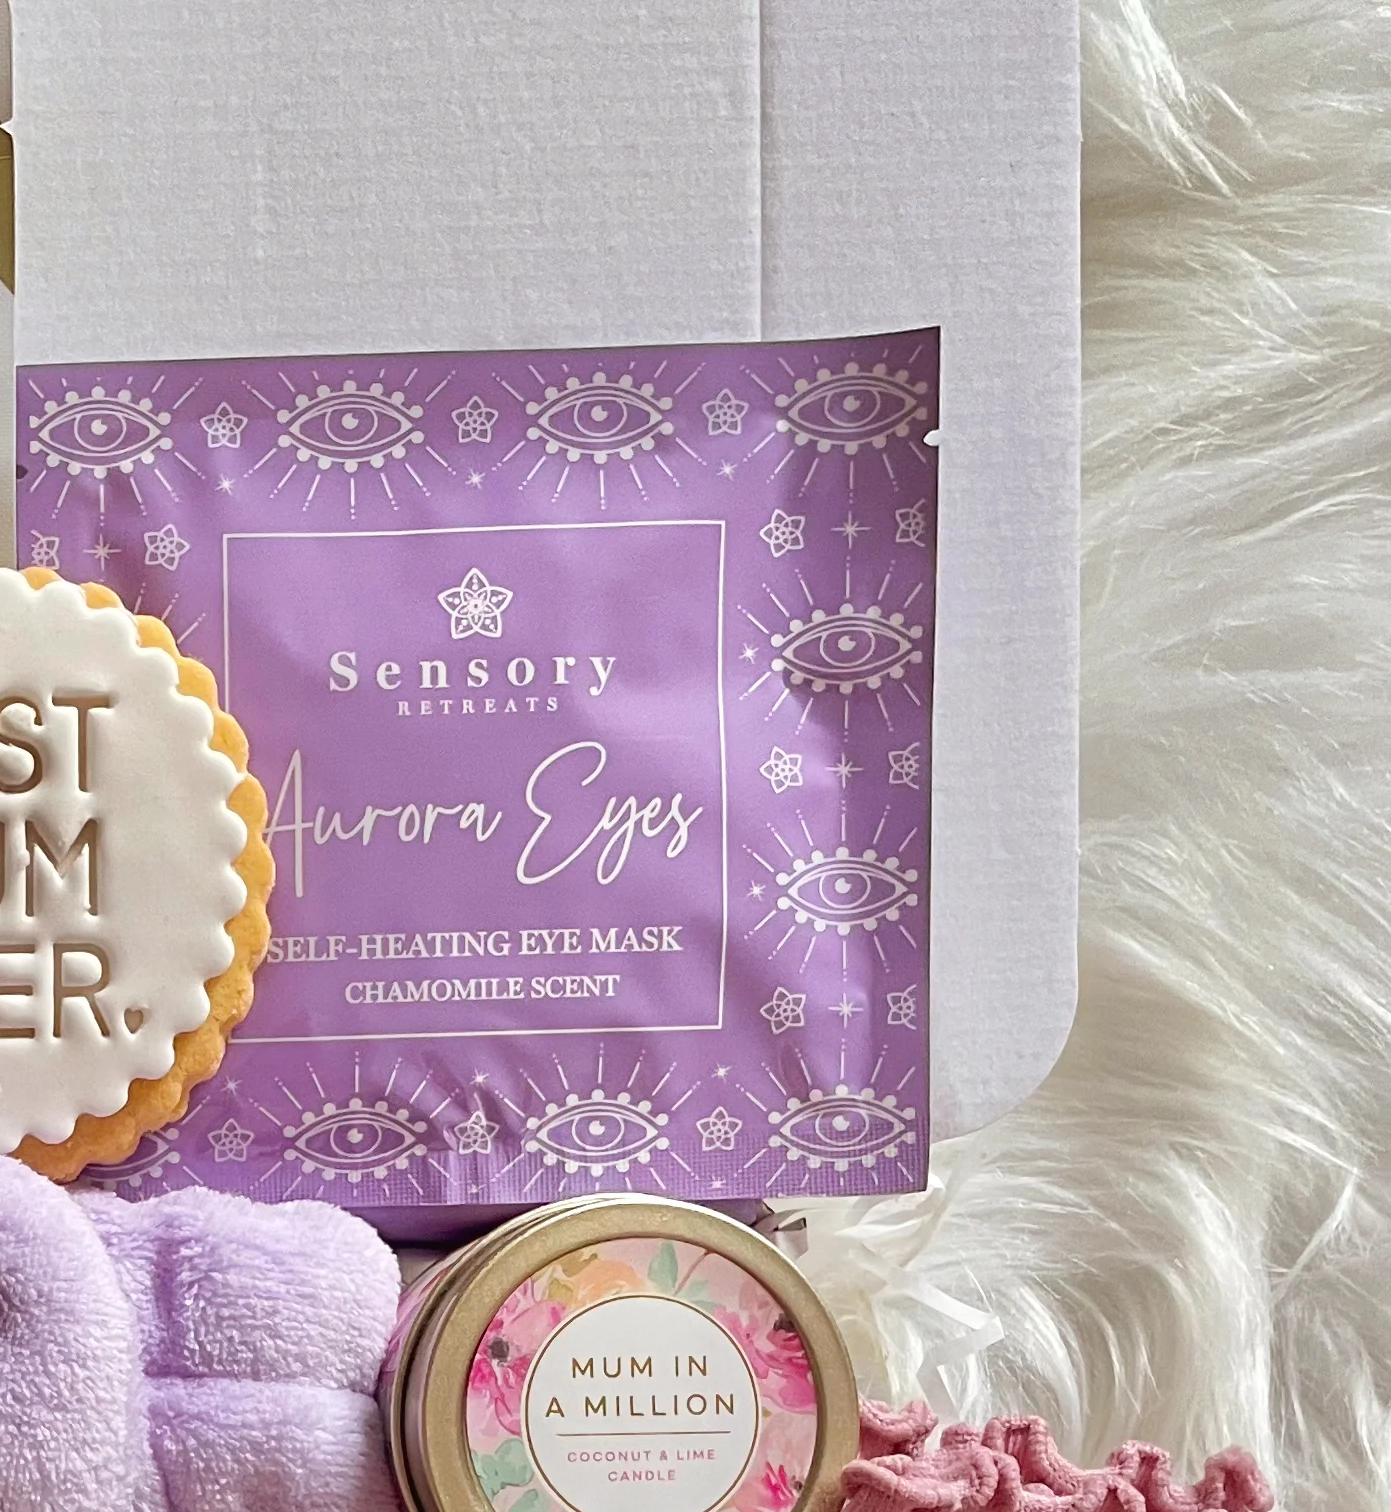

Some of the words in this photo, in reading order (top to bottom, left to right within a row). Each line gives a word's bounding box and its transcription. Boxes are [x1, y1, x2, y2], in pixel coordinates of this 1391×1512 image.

[327, 649, 618, 696] Sensory
[397, 697, 560, 716] RETREATS
[263, 748, 502, 898] Aurora
[515, 740, 704, 885] Eyes
[266, 930, 511, 963] SELF-HEATING
[518, 928, 583, 956] EYE
[589, 925, 684, 954] MASK
[343, 976, 526, 1005] CHAMOMILE
[529, 973, 622, 1000] SCENT
[571, 1356, 654, 1379] MUM
[674, 1355, 709, 1378] IN
[544, 1396, 565, 1419] A
[583, 1393, 736, 1418] MILLION
[566, 1450, 651, 1463] COCONUT
[659, 1449, 669, 1462] &
[676, 1448, 716, 1461] LIME
[607, 1469, 677, 1483] CANDLE
